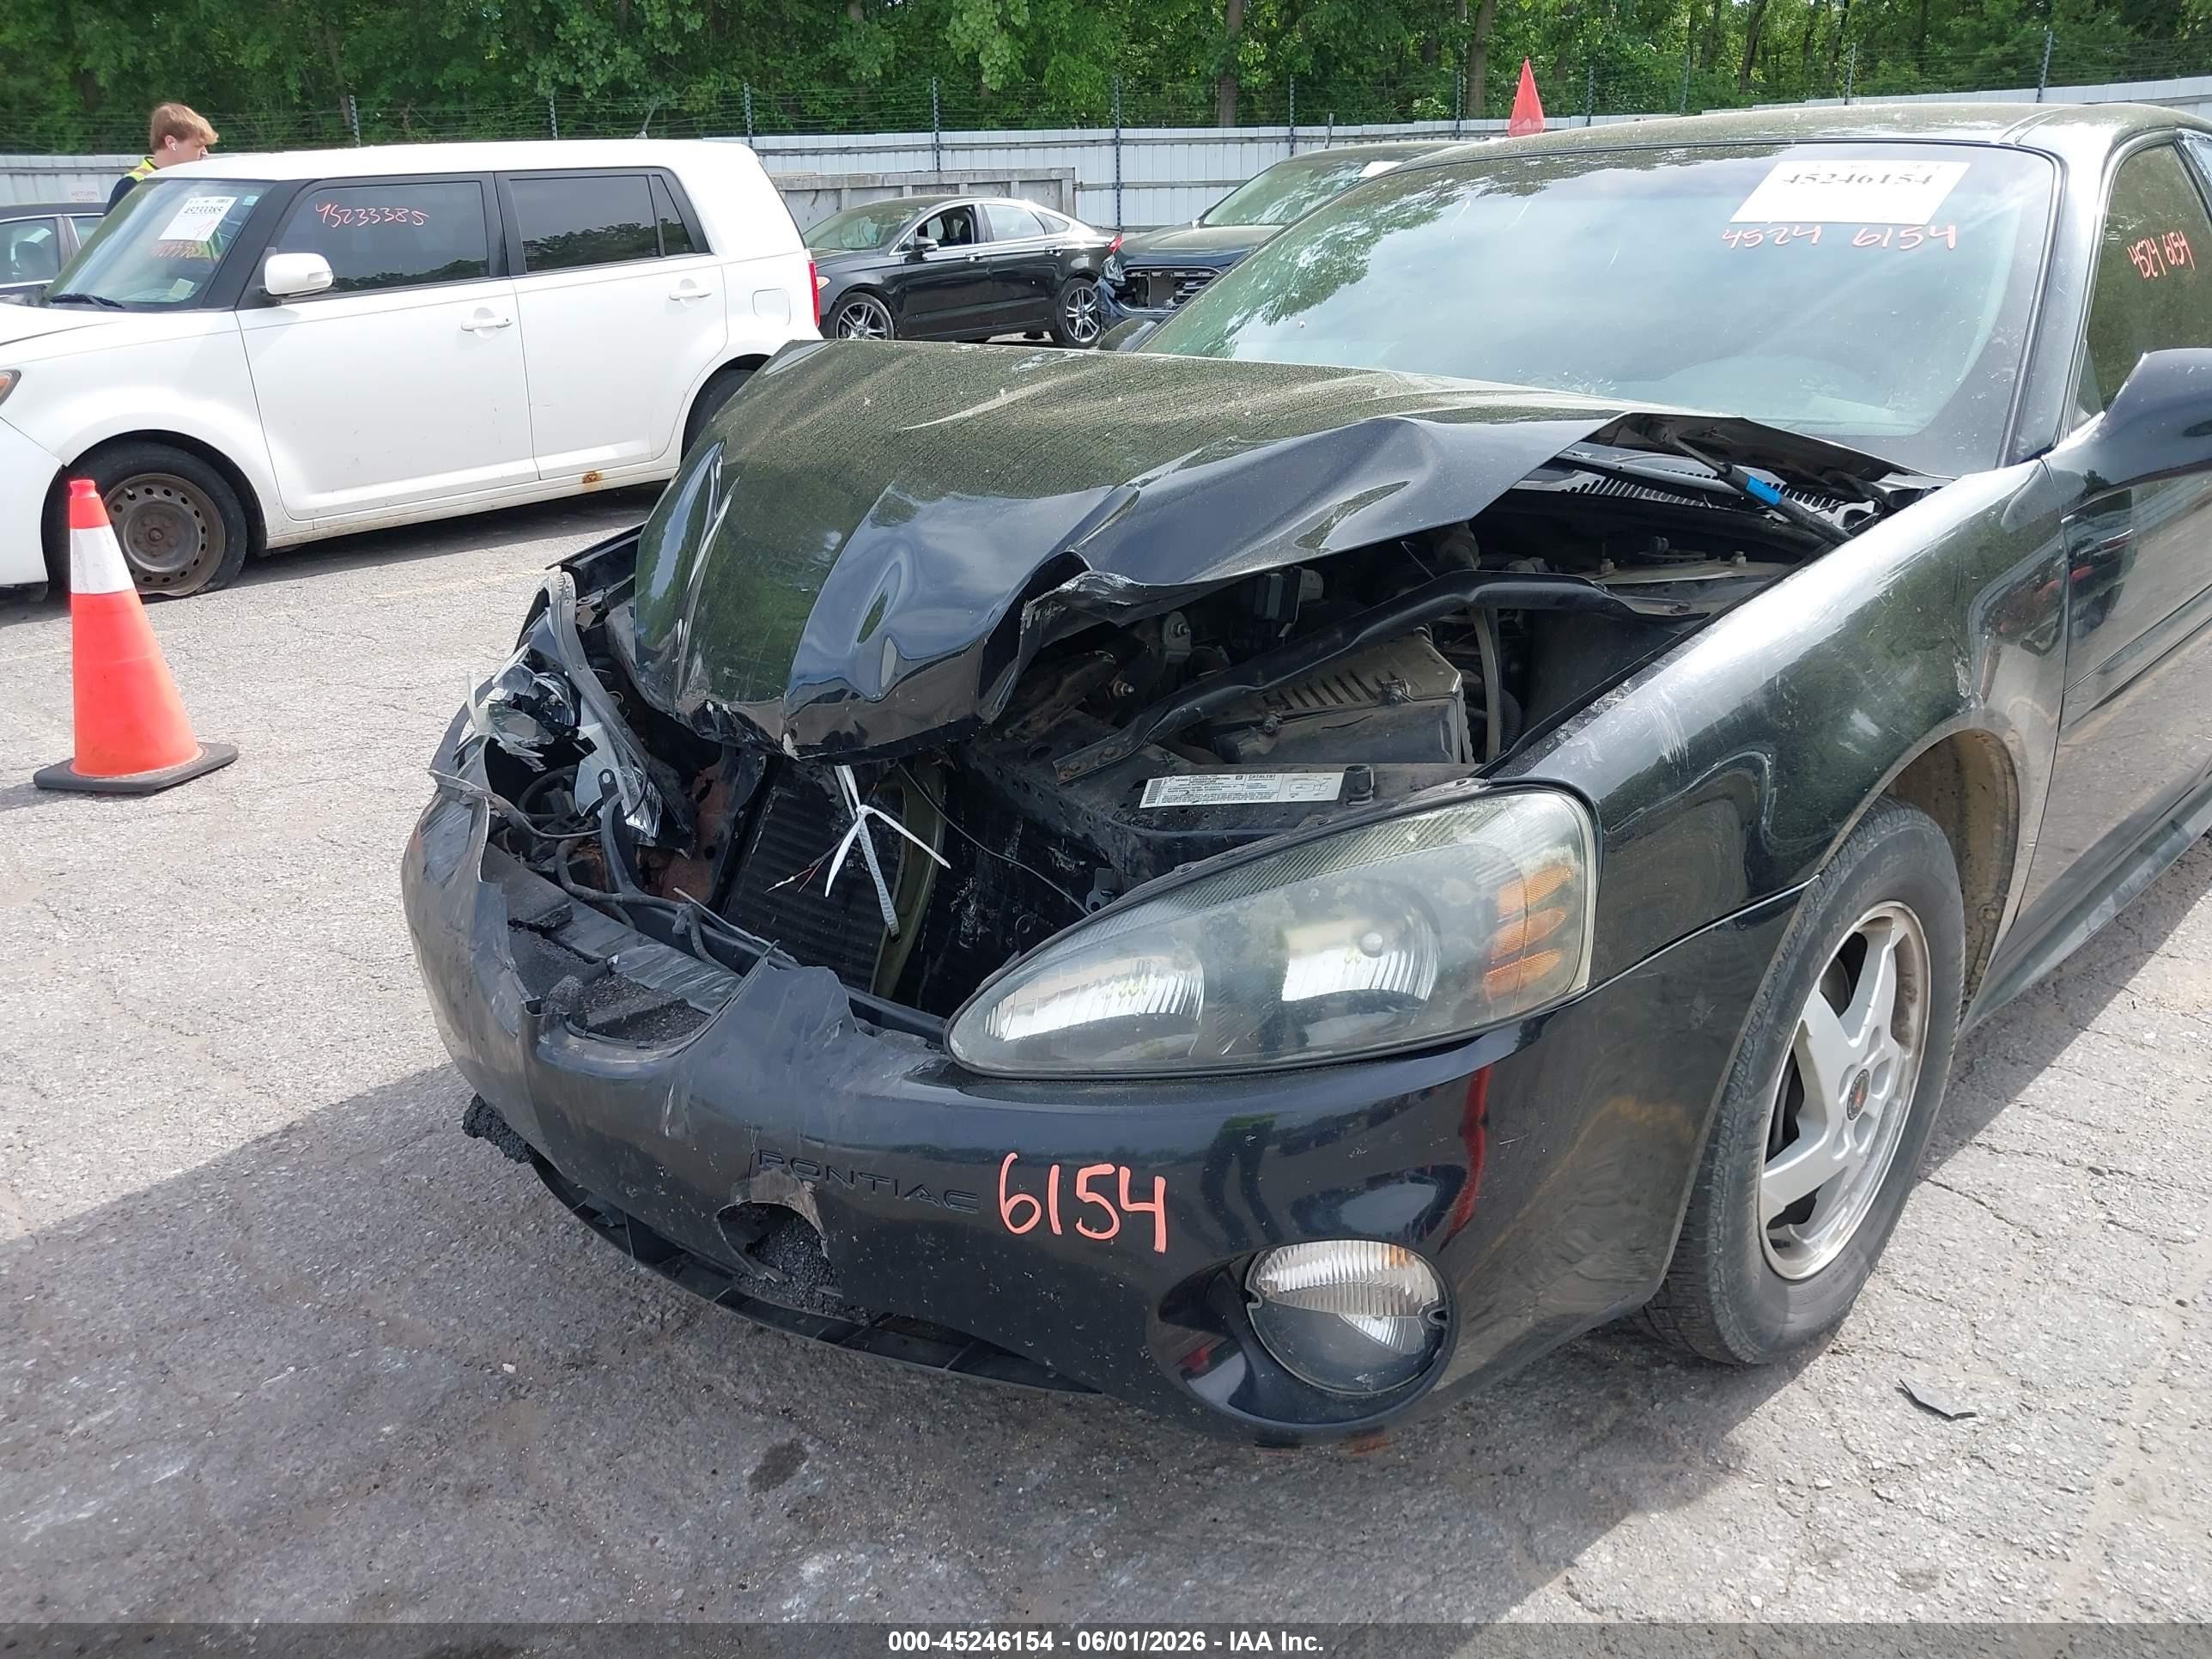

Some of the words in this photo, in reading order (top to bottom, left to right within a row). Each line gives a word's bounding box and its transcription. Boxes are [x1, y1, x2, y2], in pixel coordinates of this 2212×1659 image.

[1782, 173, 1934, 185] 45246154
[315, 203, 430, 228] 45233385
[1721, 224, 1822, 249] 4524
[1851, 224, 1957, 251] 6154
[2126, 236, 2167, 279] 4524
[2161, 229, 2196, 271] 6154
[758, 1148, 980, 1215] PONTIAC
[998, 1152, 1168, 1254] 6154
